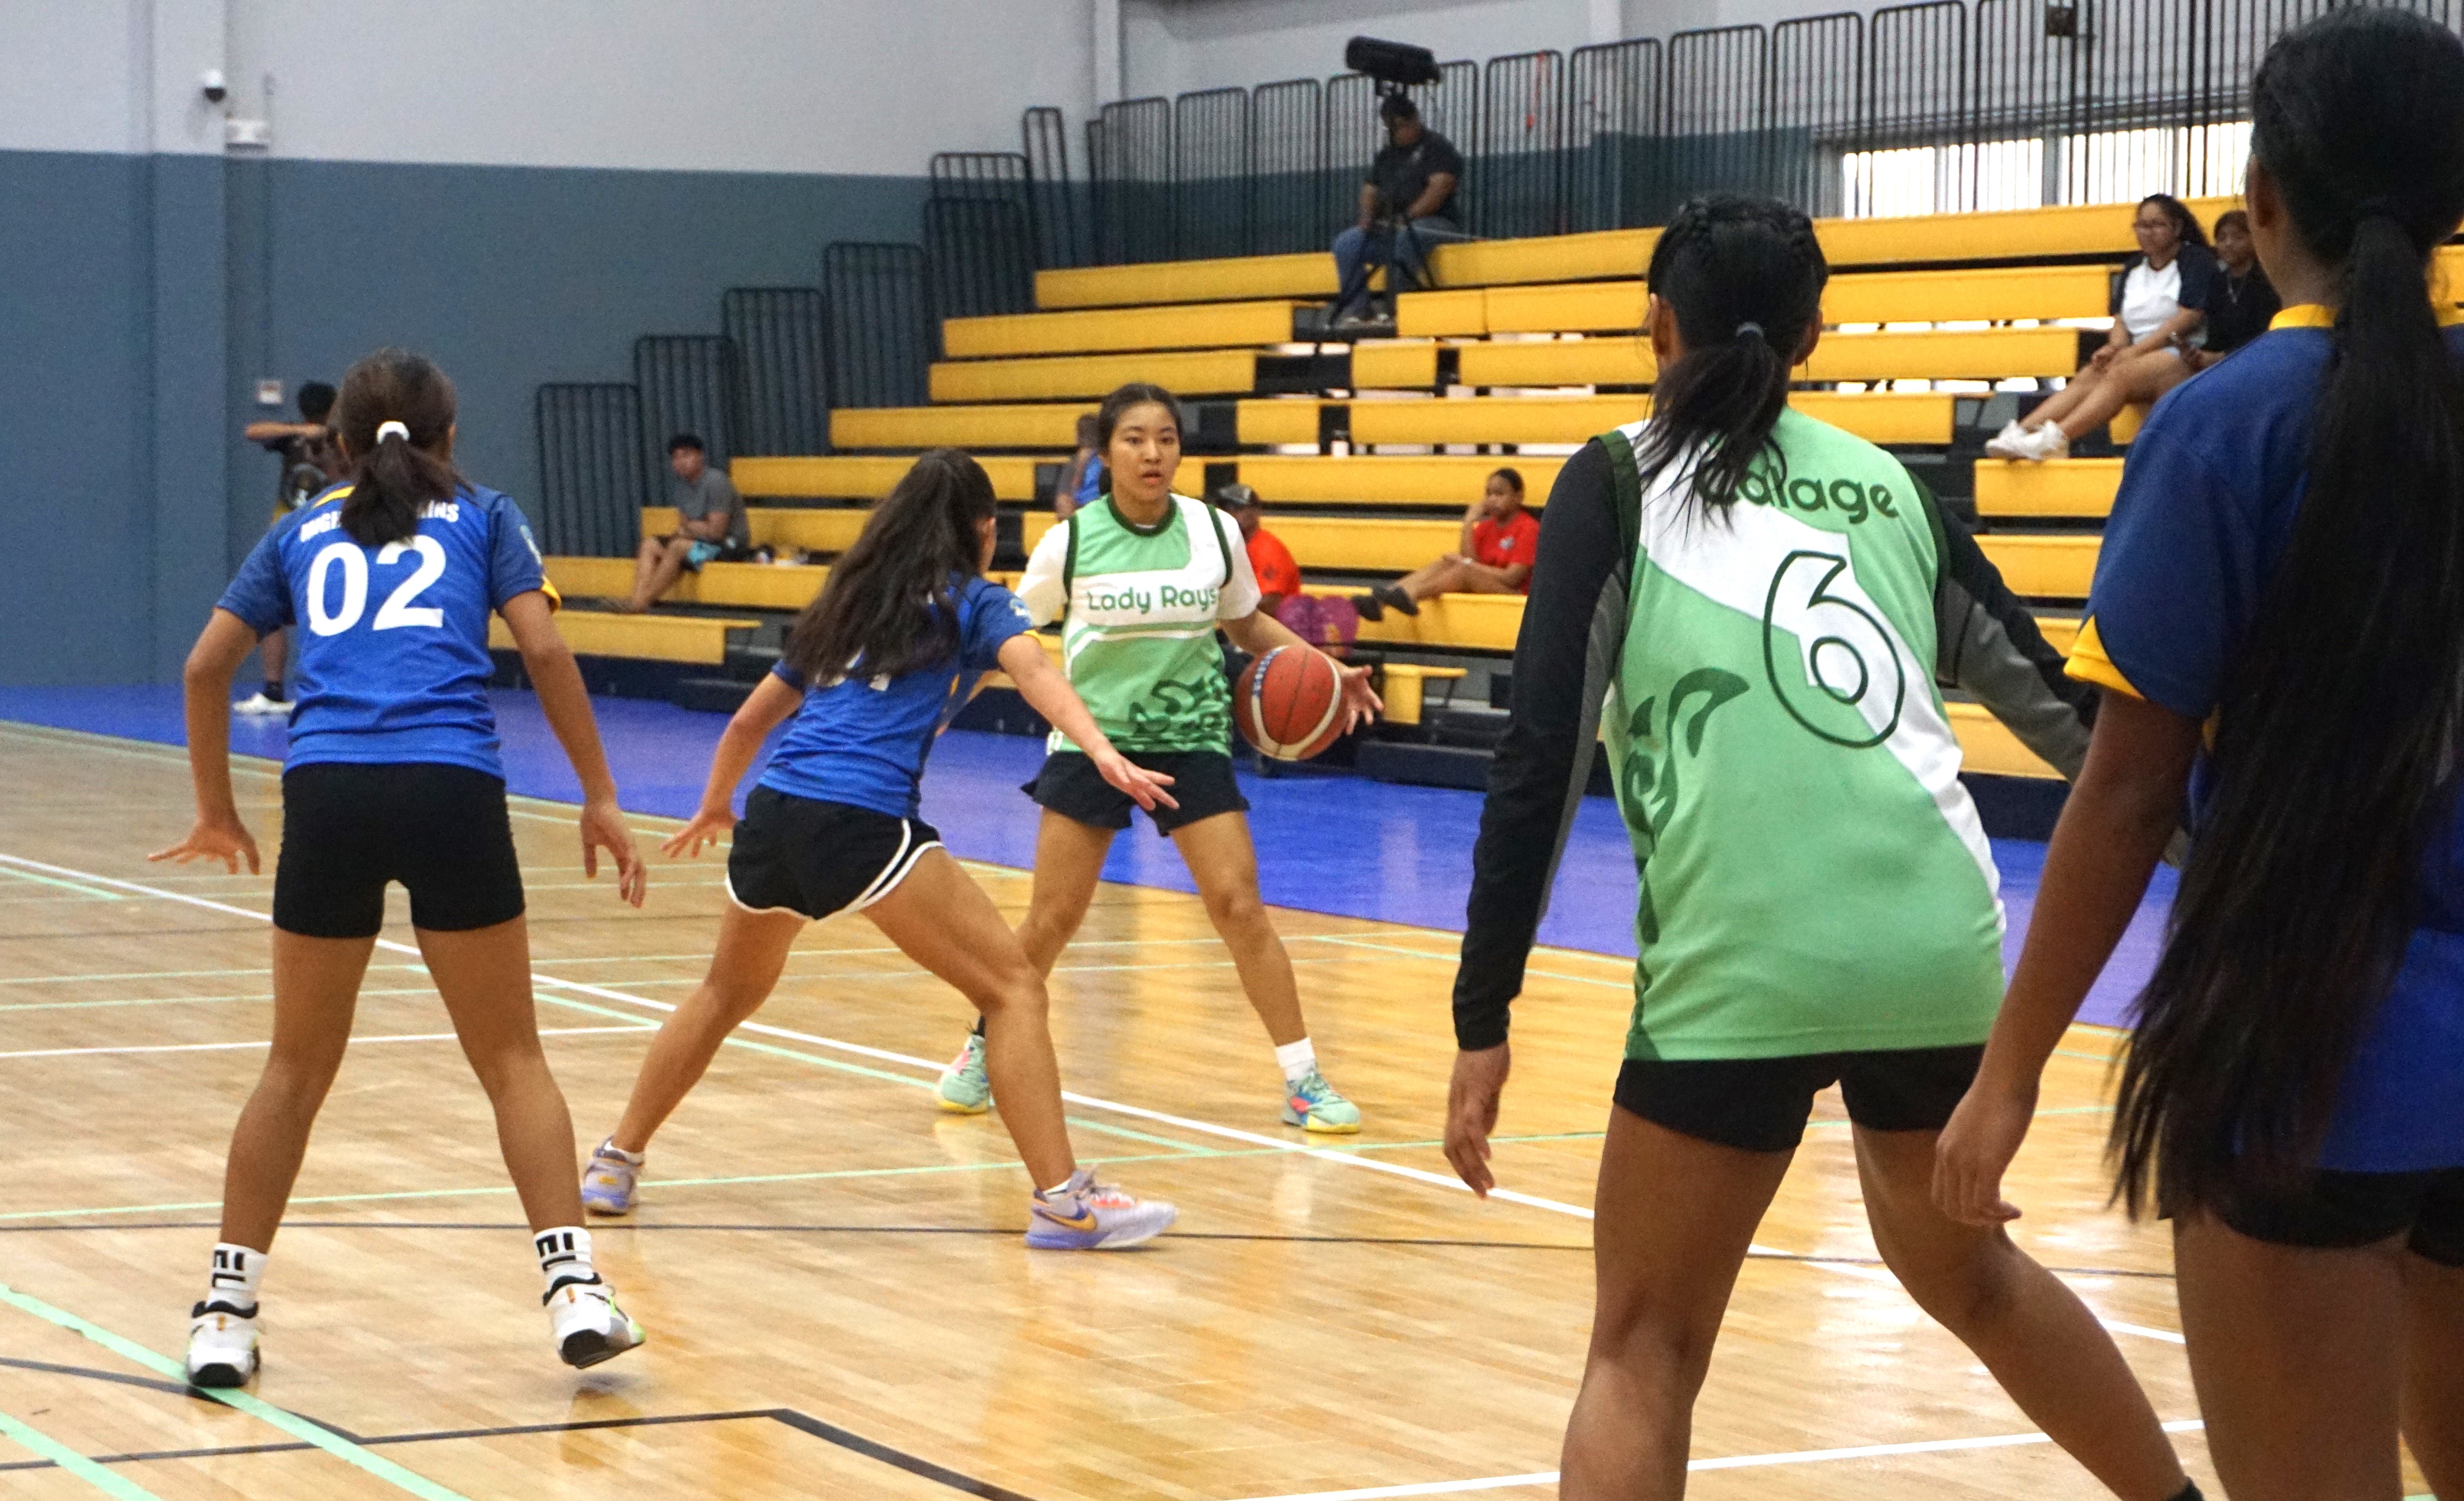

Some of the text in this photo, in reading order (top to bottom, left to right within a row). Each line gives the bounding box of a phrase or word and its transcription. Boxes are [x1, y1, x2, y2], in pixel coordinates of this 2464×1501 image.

[307, 535, 447, 636] 02
[1086, 584, 1217, 614] Lady Rays
[1763, 549, 1905, 748] 6
